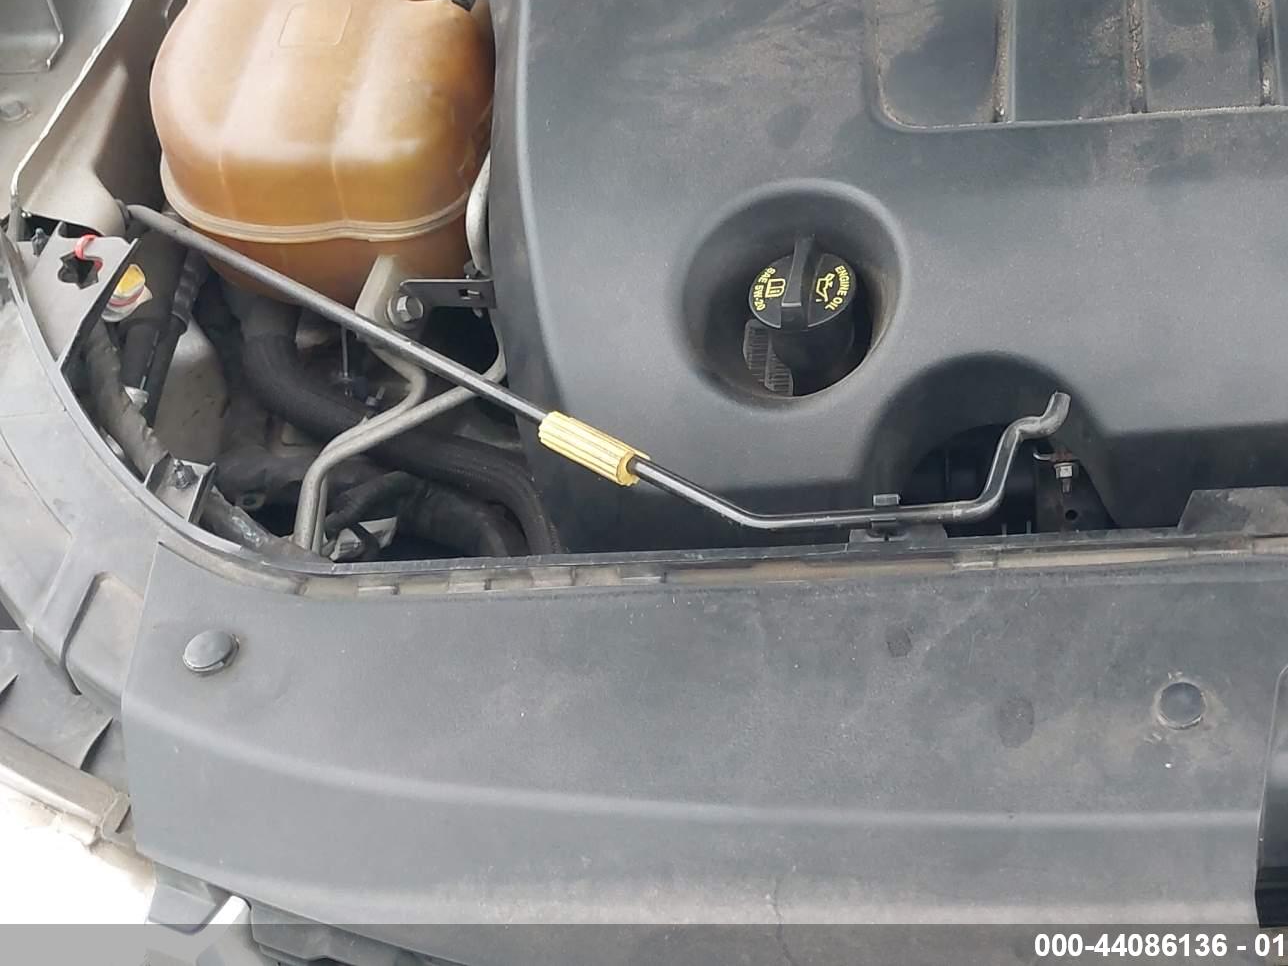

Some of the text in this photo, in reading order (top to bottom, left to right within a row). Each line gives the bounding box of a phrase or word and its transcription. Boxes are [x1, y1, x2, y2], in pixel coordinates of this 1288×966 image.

[753, 267, 776, 311] SAE 5W-20
[825, 265, 850, 311] ENGINE OIL
